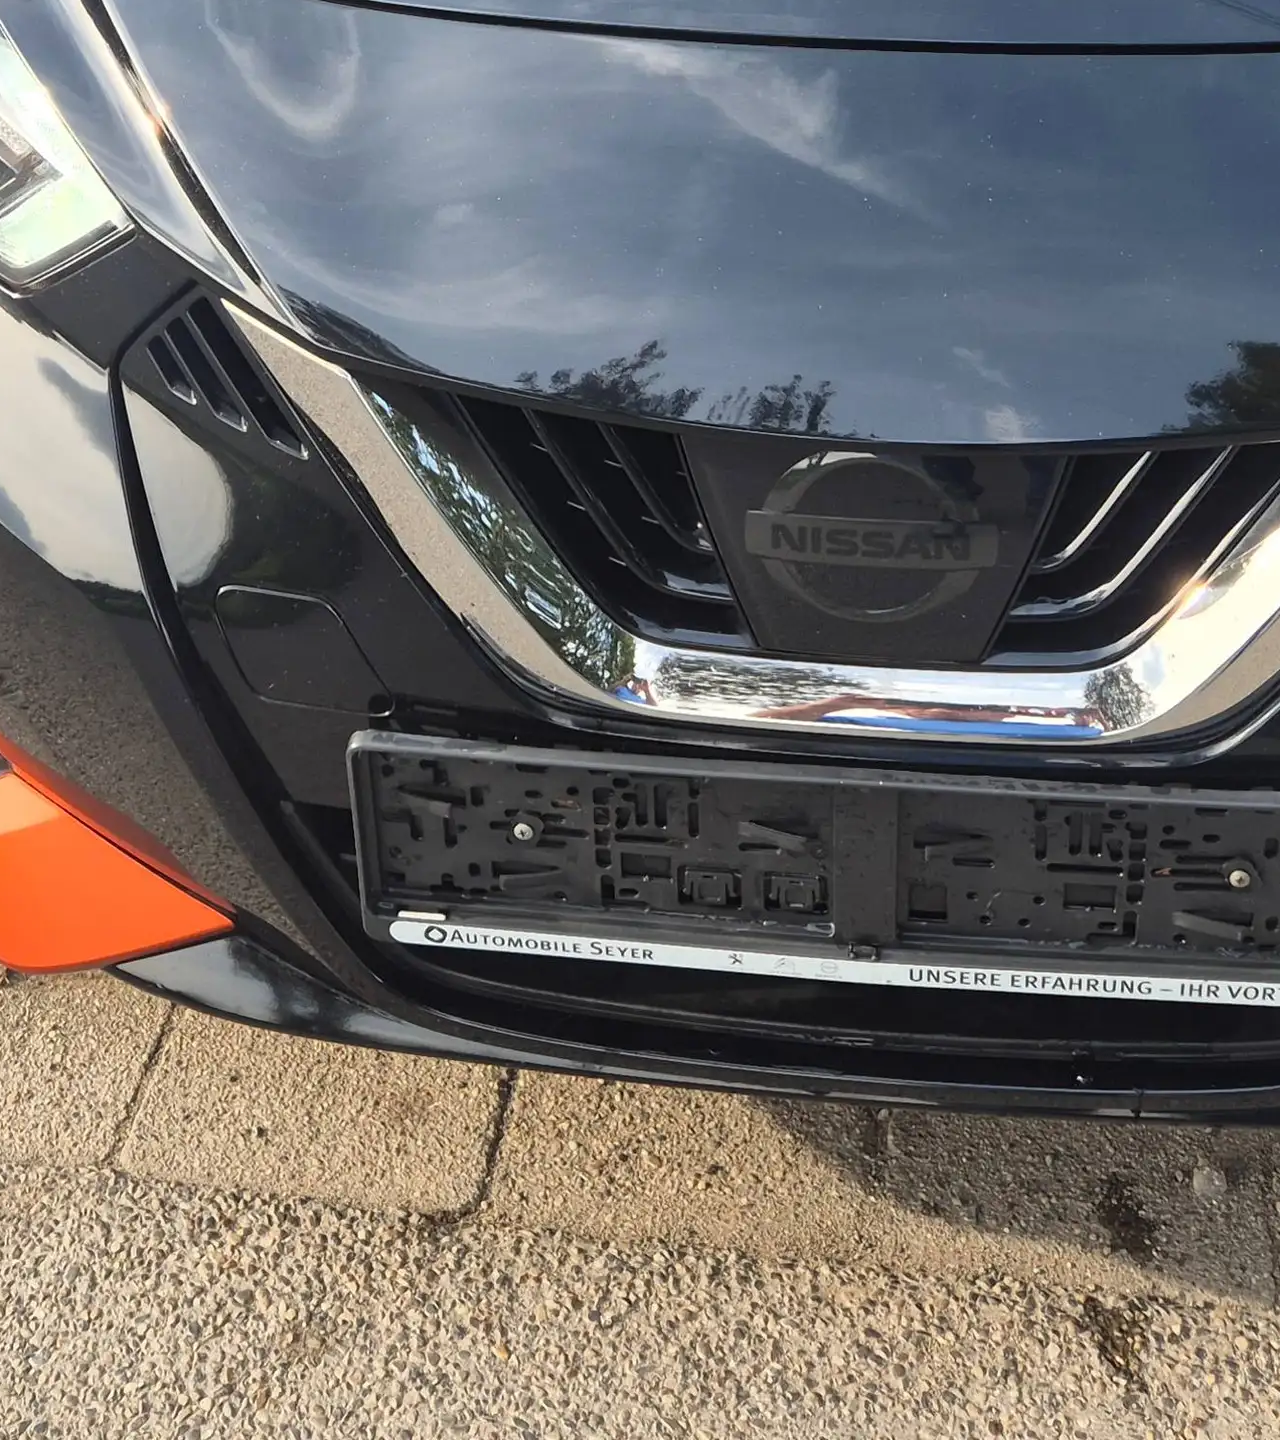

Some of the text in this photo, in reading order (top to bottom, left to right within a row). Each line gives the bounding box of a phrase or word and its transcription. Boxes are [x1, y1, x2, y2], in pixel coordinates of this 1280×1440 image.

[770, 522, 970, 561] NISSAN
[908, 968, 1001, 988] UNSERE
[1010, 973, 1152, 997] ERFAHRUNG
[1179, 981, 1220, 1000] IHR
